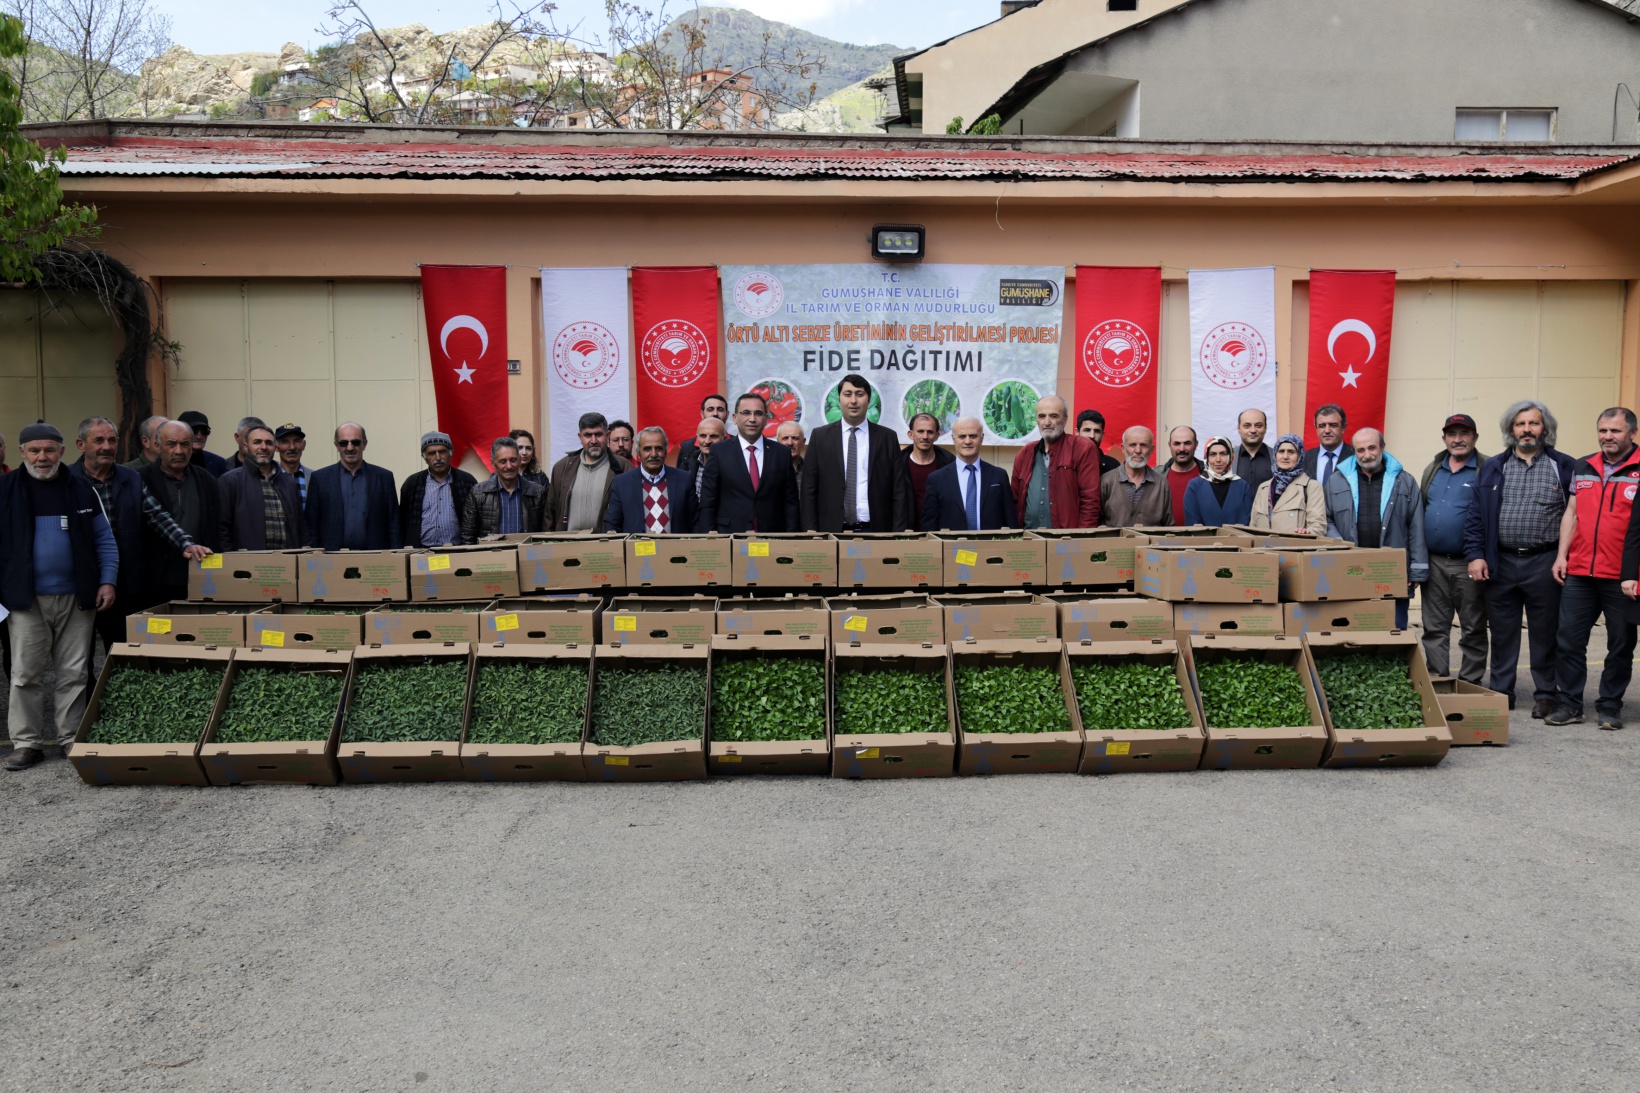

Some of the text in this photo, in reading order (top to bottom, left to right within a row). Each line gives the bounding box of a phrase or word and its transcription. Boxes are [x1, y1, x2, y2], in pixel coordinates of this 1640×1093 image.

[881, 272, 901, 283] T.C.
[821, 286, 902, 299] GÜMÜŞHANE
[1001, 287, 1050, 299] GÜMÜŞHANE
[786, 301, 995, 314] İL TARIM VE ORMAN MÜDÜRLÜĞÜ
[727, 320, 1059, 345] ÖRTÜ ALTI SEBZE ÜRETİMİNİN GELİŞTİRİLMESİ PROJESİ
[803, 343, 983, 372] FİDE DAĞITIMI
